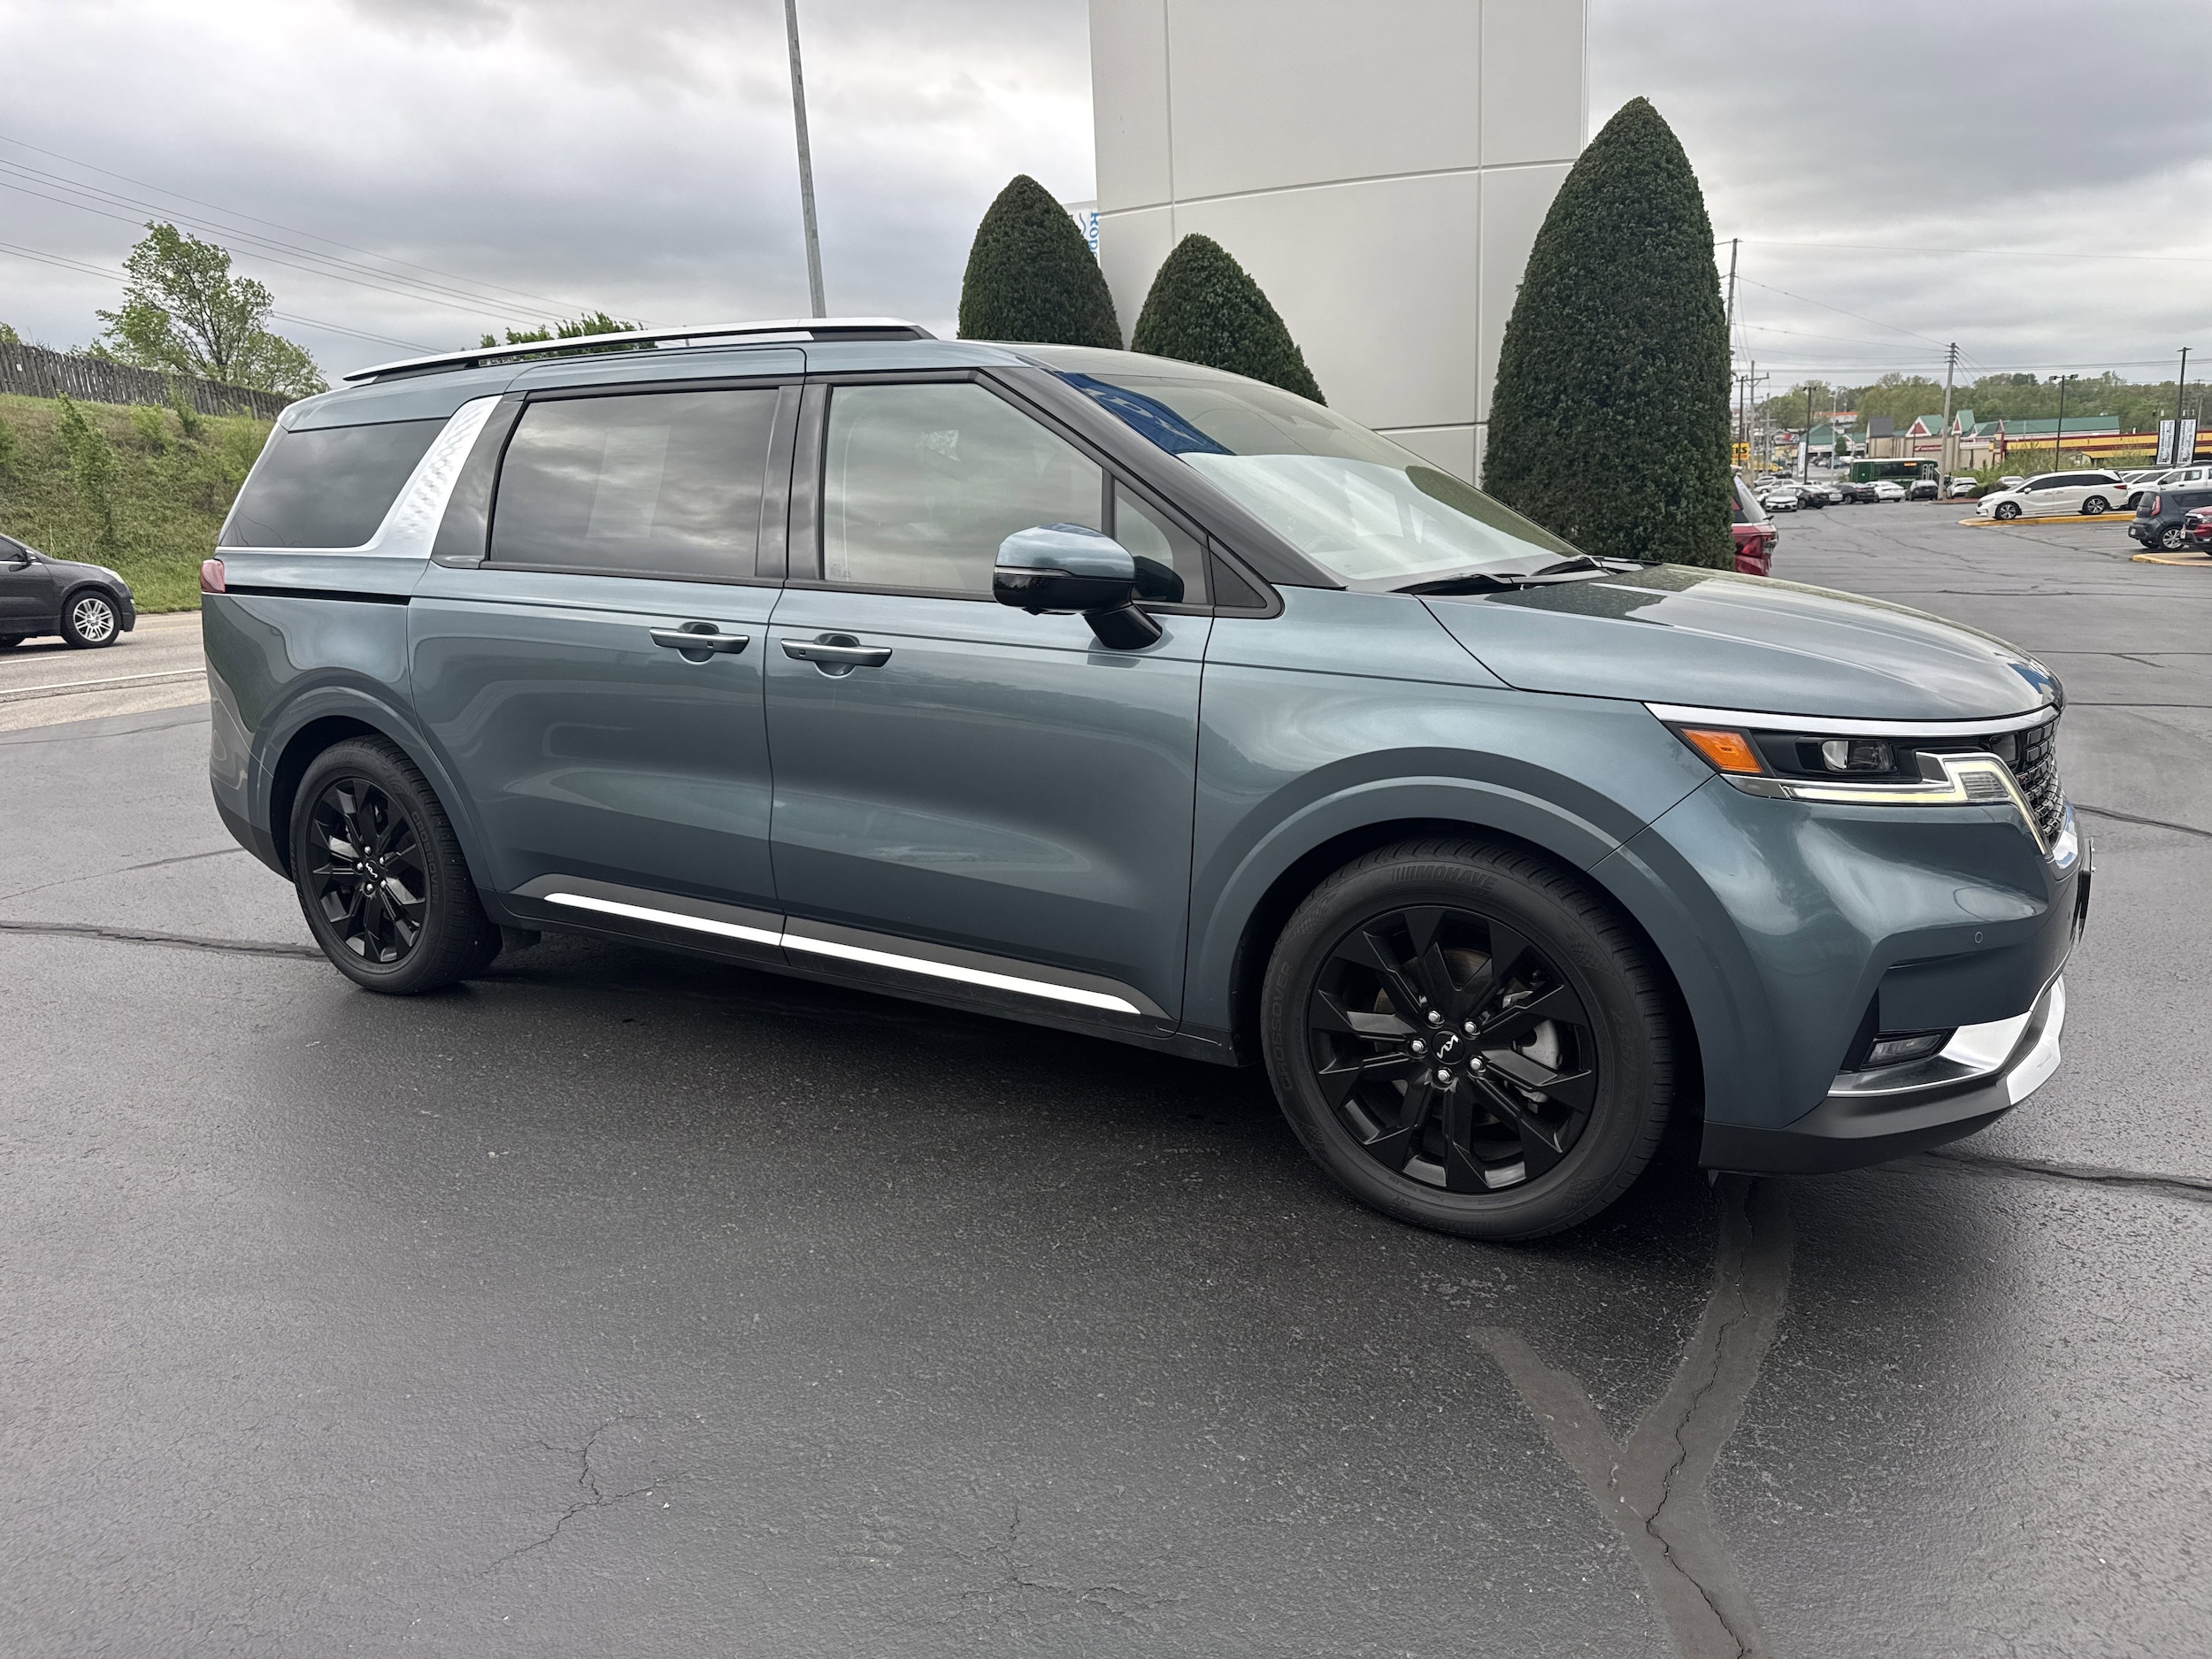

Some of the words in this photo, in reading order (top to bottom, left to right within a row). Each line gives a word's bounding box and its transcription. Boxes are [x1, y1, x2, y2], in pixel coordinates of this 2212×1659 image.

[411, 810, 440, 905] CROSSOVER
[1416, 865, 1499, 890] MOHAVE
[1268, 961, 1294, 1091] CROSSOVER
